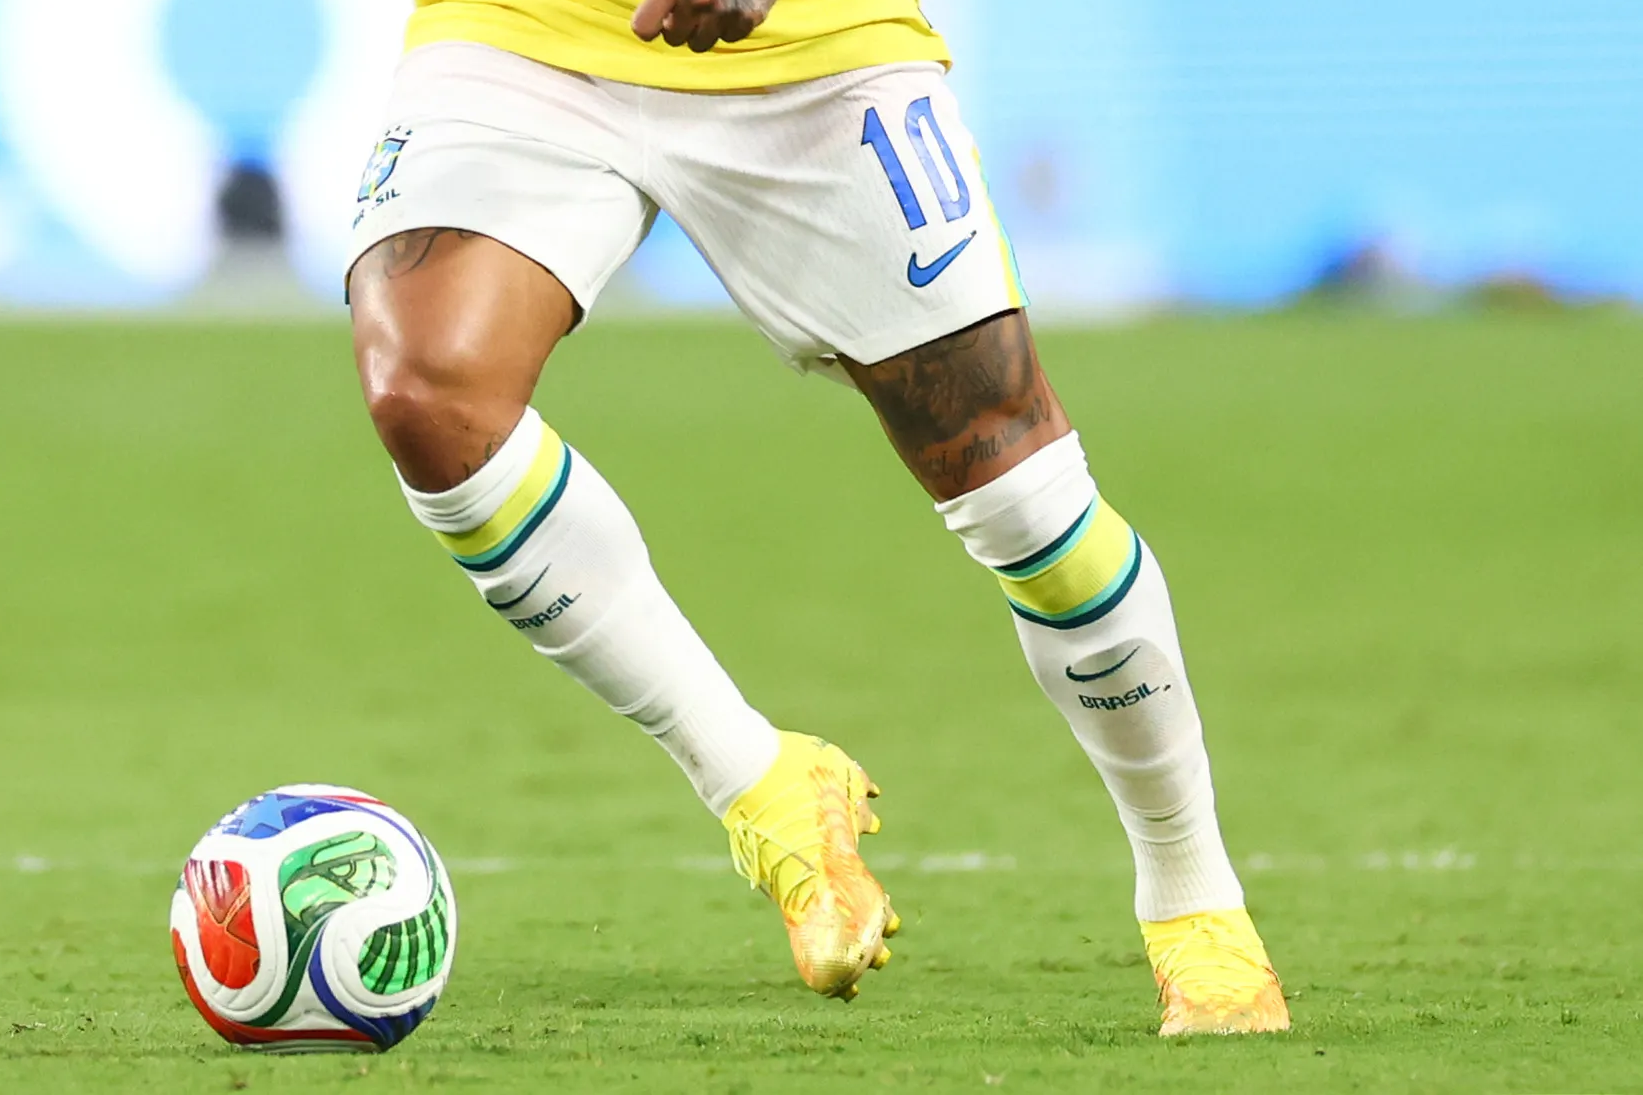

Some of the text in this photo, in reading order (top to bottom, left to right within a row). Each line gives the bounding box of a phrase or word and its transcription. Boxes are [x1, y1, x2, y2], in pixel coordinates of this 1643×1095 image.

[861, 95, 970, 231] 10
[509, 593, 582, 629] BRASIL
[1078, 683, 1160, 710] BRASIL
